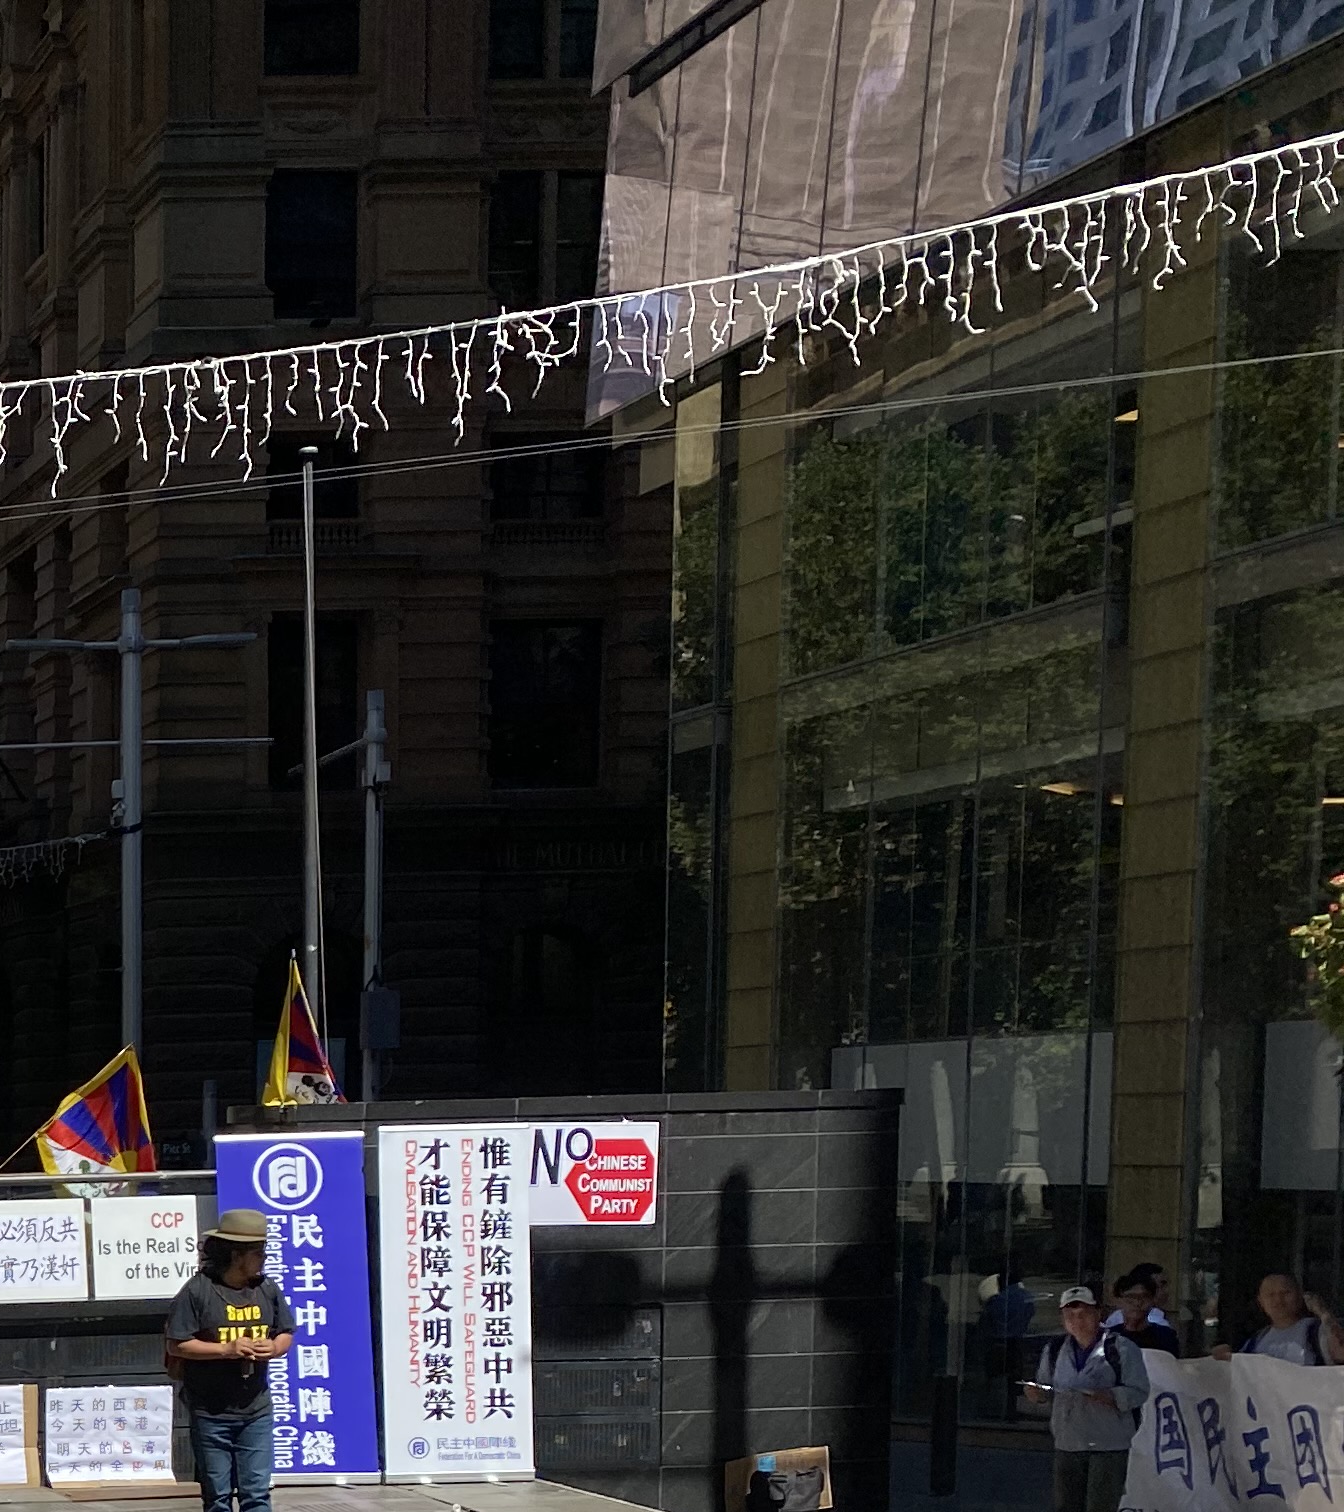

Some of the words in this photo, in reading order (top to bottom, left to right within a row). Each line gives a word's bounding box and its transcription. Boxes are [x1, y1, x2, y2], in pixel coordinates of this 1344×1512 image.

[530, 1128, 593, 1185] NO
[585, 1153, 647, 1171] CHINESE
[577, 1176, 653, 1193] COMMUNIST
[590, 1196, 638, 1214] PARTY
[151, 1212, 184, 1229] CCP
[462, 1213, 474, 1257] CCP
[99, 1240, 111, 1255] Is
[116, 1239, 141, 1255] the
[147, 1237, 180, 1254] Real
[125, 1263, 141, 1279] of
[146, 1262, 170, 1279] the
[419, 1137, 456, 1421] 才能保障文明繁榮
[225, 1304, 262, 1322] Save
[273, 1425, 299, 1470] China
